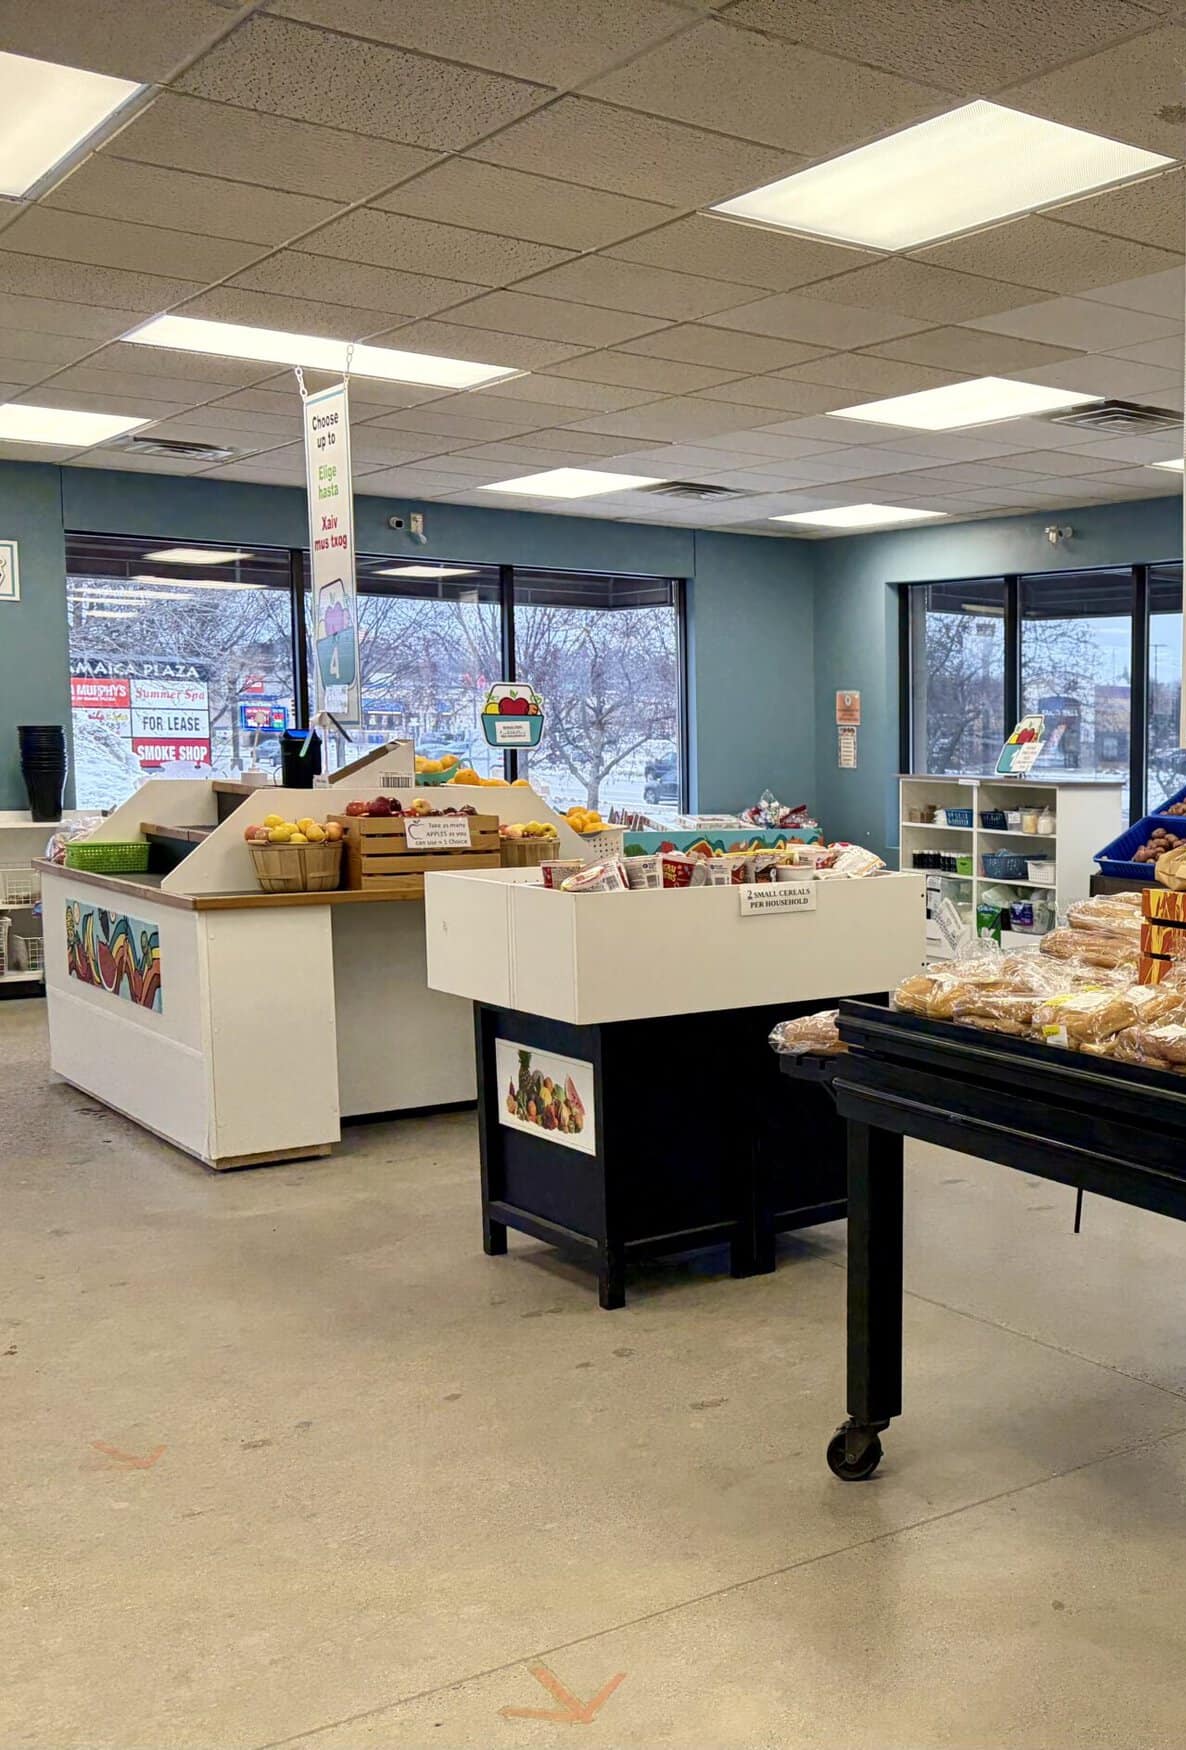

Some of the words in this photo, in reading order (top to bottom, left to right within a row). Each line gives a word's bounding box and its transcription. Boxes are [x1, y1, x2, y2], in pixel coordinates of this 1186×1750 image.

[312, 412, 338, 430] Choose
[316, 436, 327, 452] up
[327, 431, 336, 446] to
[319, 465, 337, 482] Elige
[318, 483, 339, 501] hasta
[322, 514, 338, 531] Xaiv
[314, 538, 329, 553] mus
[331, 534, 348, 550] txog
[329, 643, 340, 679] 4
[144, 664, 199, 677] PLAZA
[135, 687, 181, 700] Summer
[184, 689, 205, 702] Spa
[143, 716, 164, 731] FOR
[167, 716, 200, 731] LEASE
[137, 745, 176, 761] SMOKE
[179, 746, 208, 761] SHOP
[747, 889, 753, 900] 2
[754, 890, 777, 899] SMALL
[778, 888, 811, 897] CEREALS
[750, 900, 764, 909] PER
[765, 898, 809, 908] HOUSEHOLD
